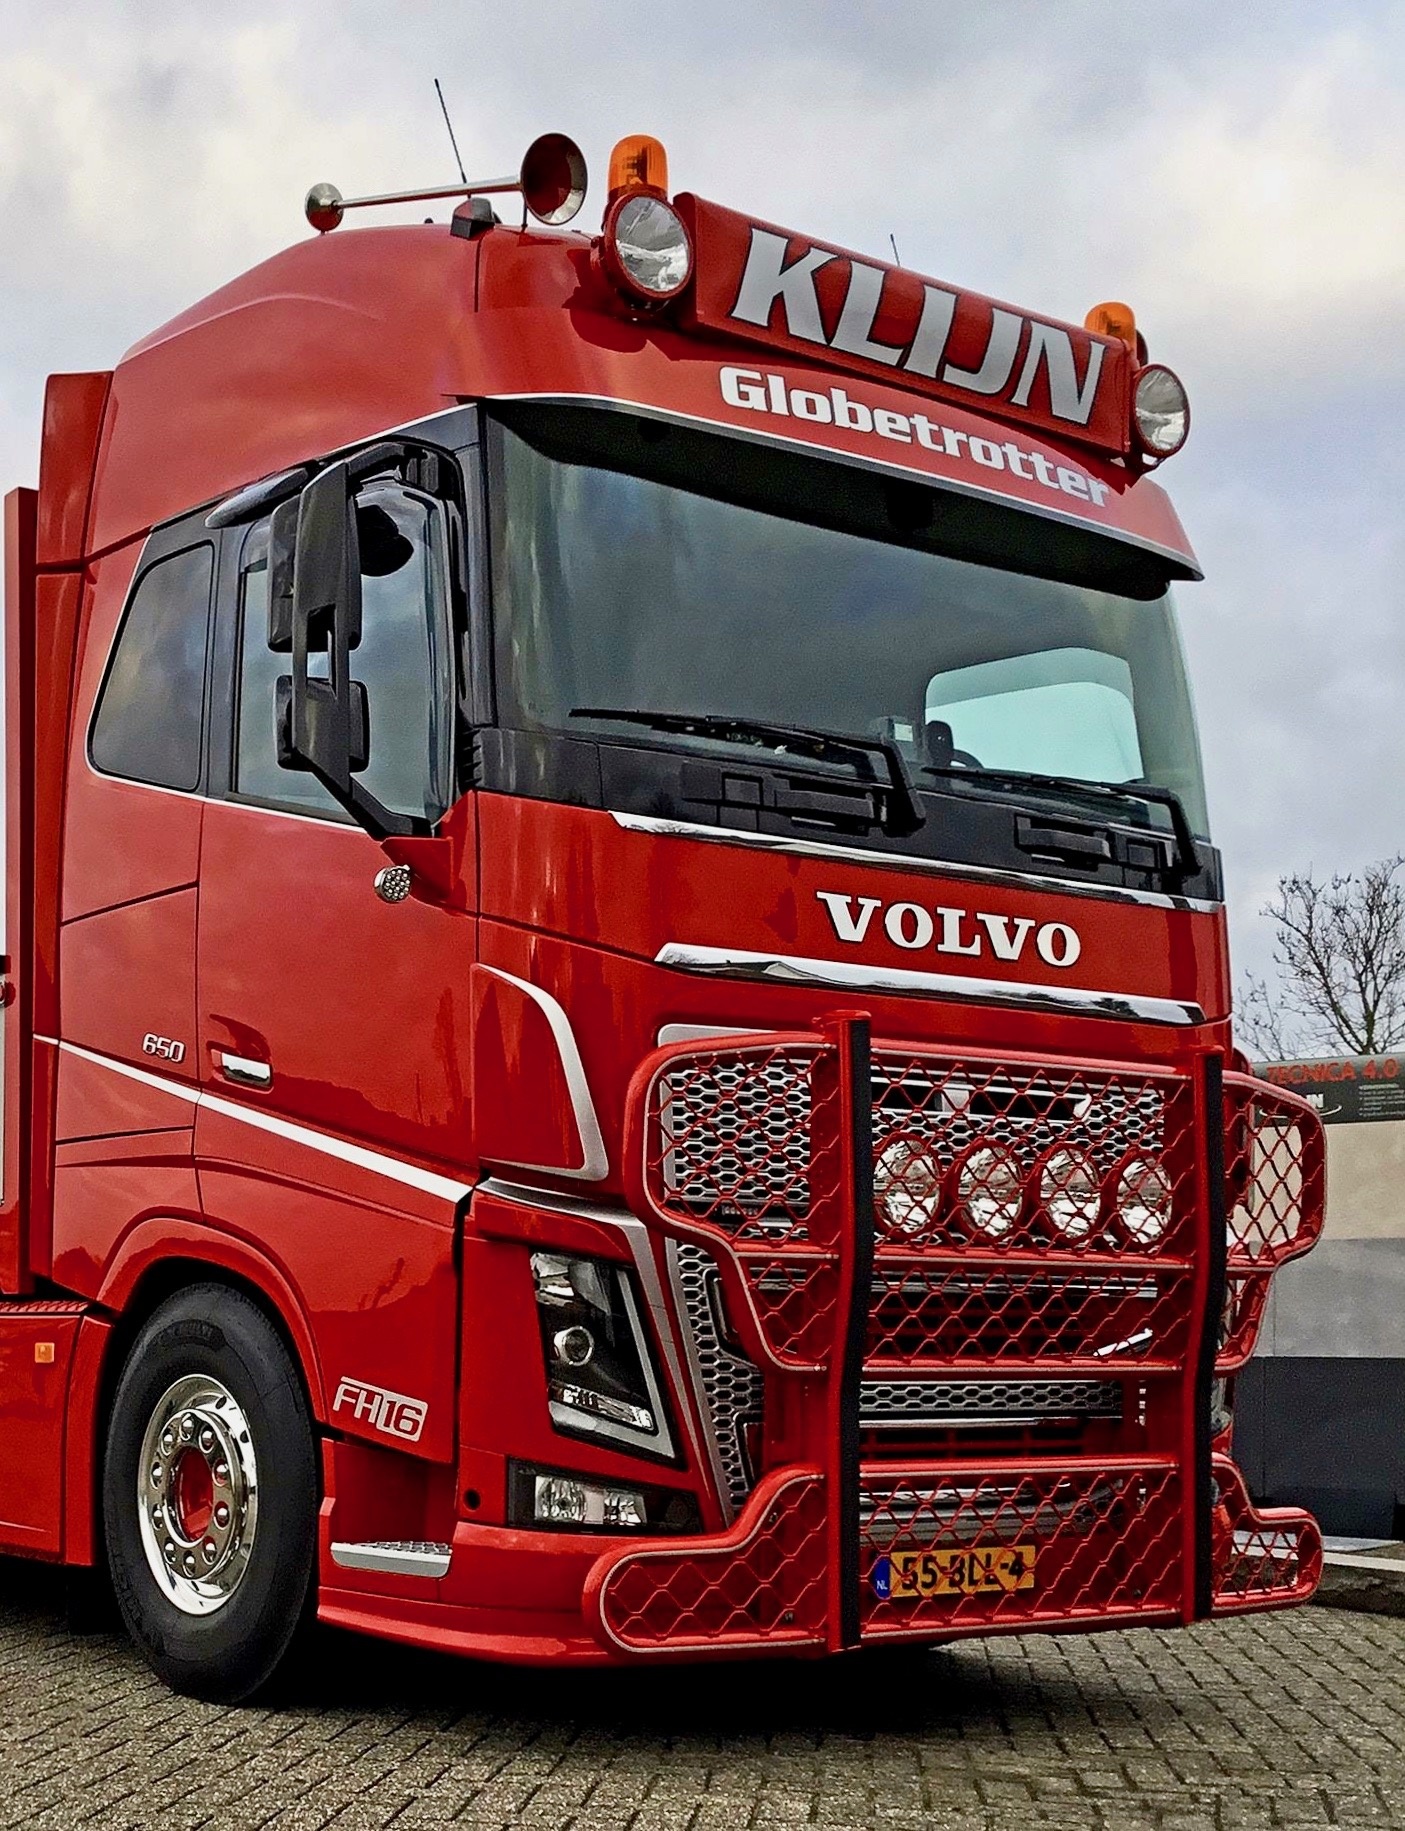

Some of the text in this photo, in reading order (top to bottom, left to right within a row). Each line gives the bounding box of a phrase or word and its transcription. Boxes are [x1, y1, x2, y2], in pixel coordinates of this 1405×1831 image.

[731, 228, 1105, 424] KLIJN
[719, 365, 1110, 507] Globetrotter
[816, 891, 1082, 967] VOLVO
[142, 1033, 185, 1063] 650
[1266, 1058, 1398, 1085] TECNICA 4.0
[332, 1380, 426, 1439] FH16
[876, 1580, 888, 1590] NL
